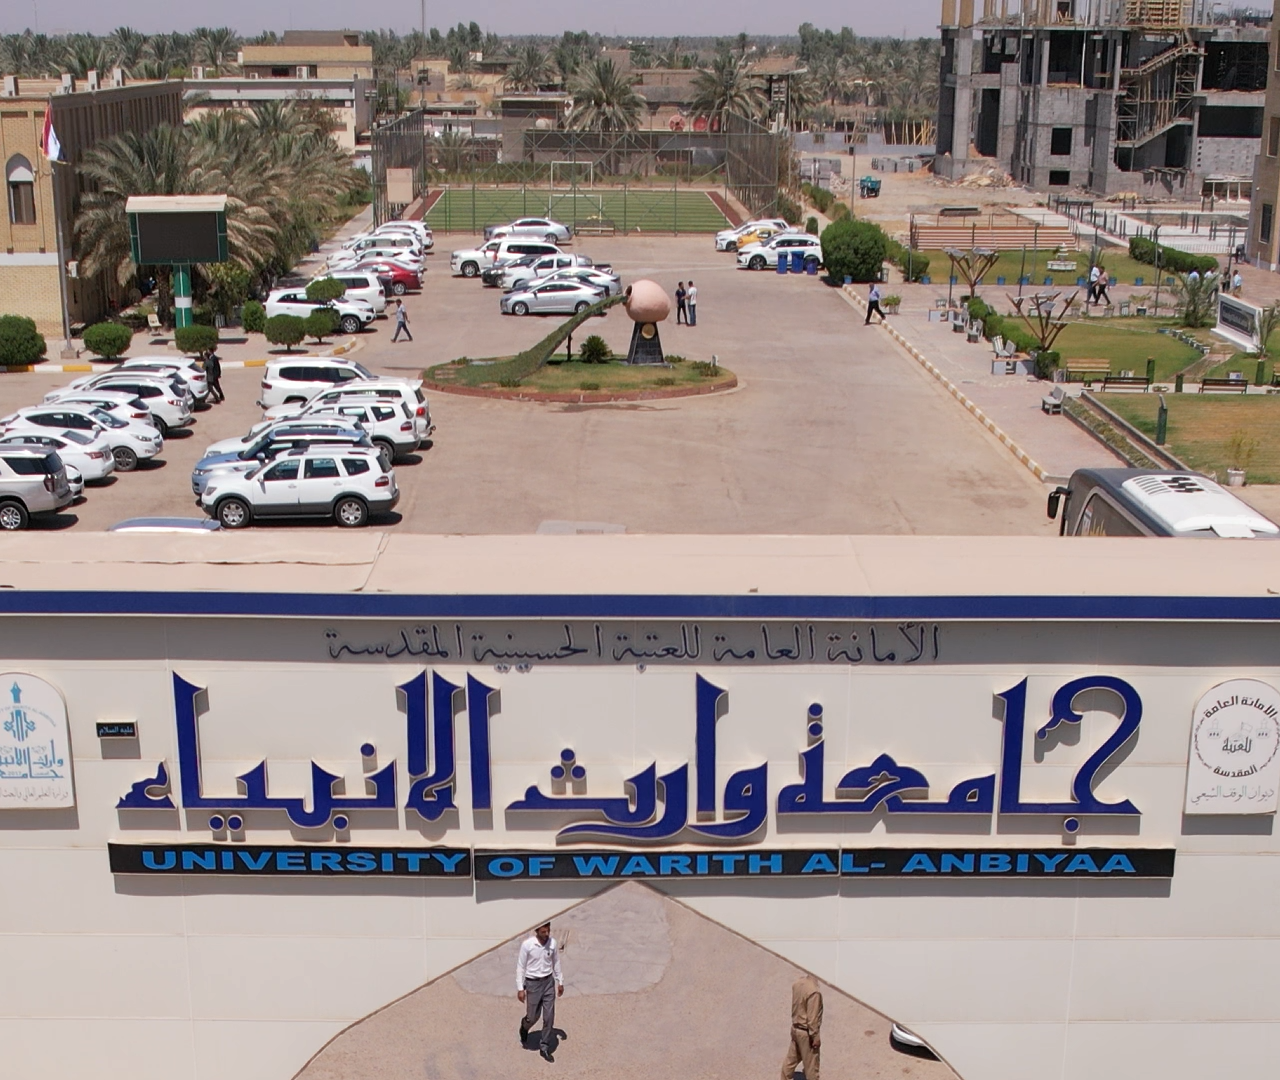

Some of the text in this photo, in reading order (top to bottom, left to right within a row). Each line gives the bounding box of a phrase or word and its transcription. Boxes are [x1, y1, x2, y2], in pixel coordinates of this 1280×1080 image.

[326, 623, 463, 660] المقدسة
[471, 623, 604, 672] الحسينية
[612, 622, 701, 672] للعتبة
[713, 624, 815, 662] العامة
[1203, 695, 1239, 719] العامة
[505, 672, 768, 840] وارث
[777, 675, 1143, 832] جامعة
[141, 850, 1137, 877] UNIVERSITY OF WARITH AL- ANBIYAA
